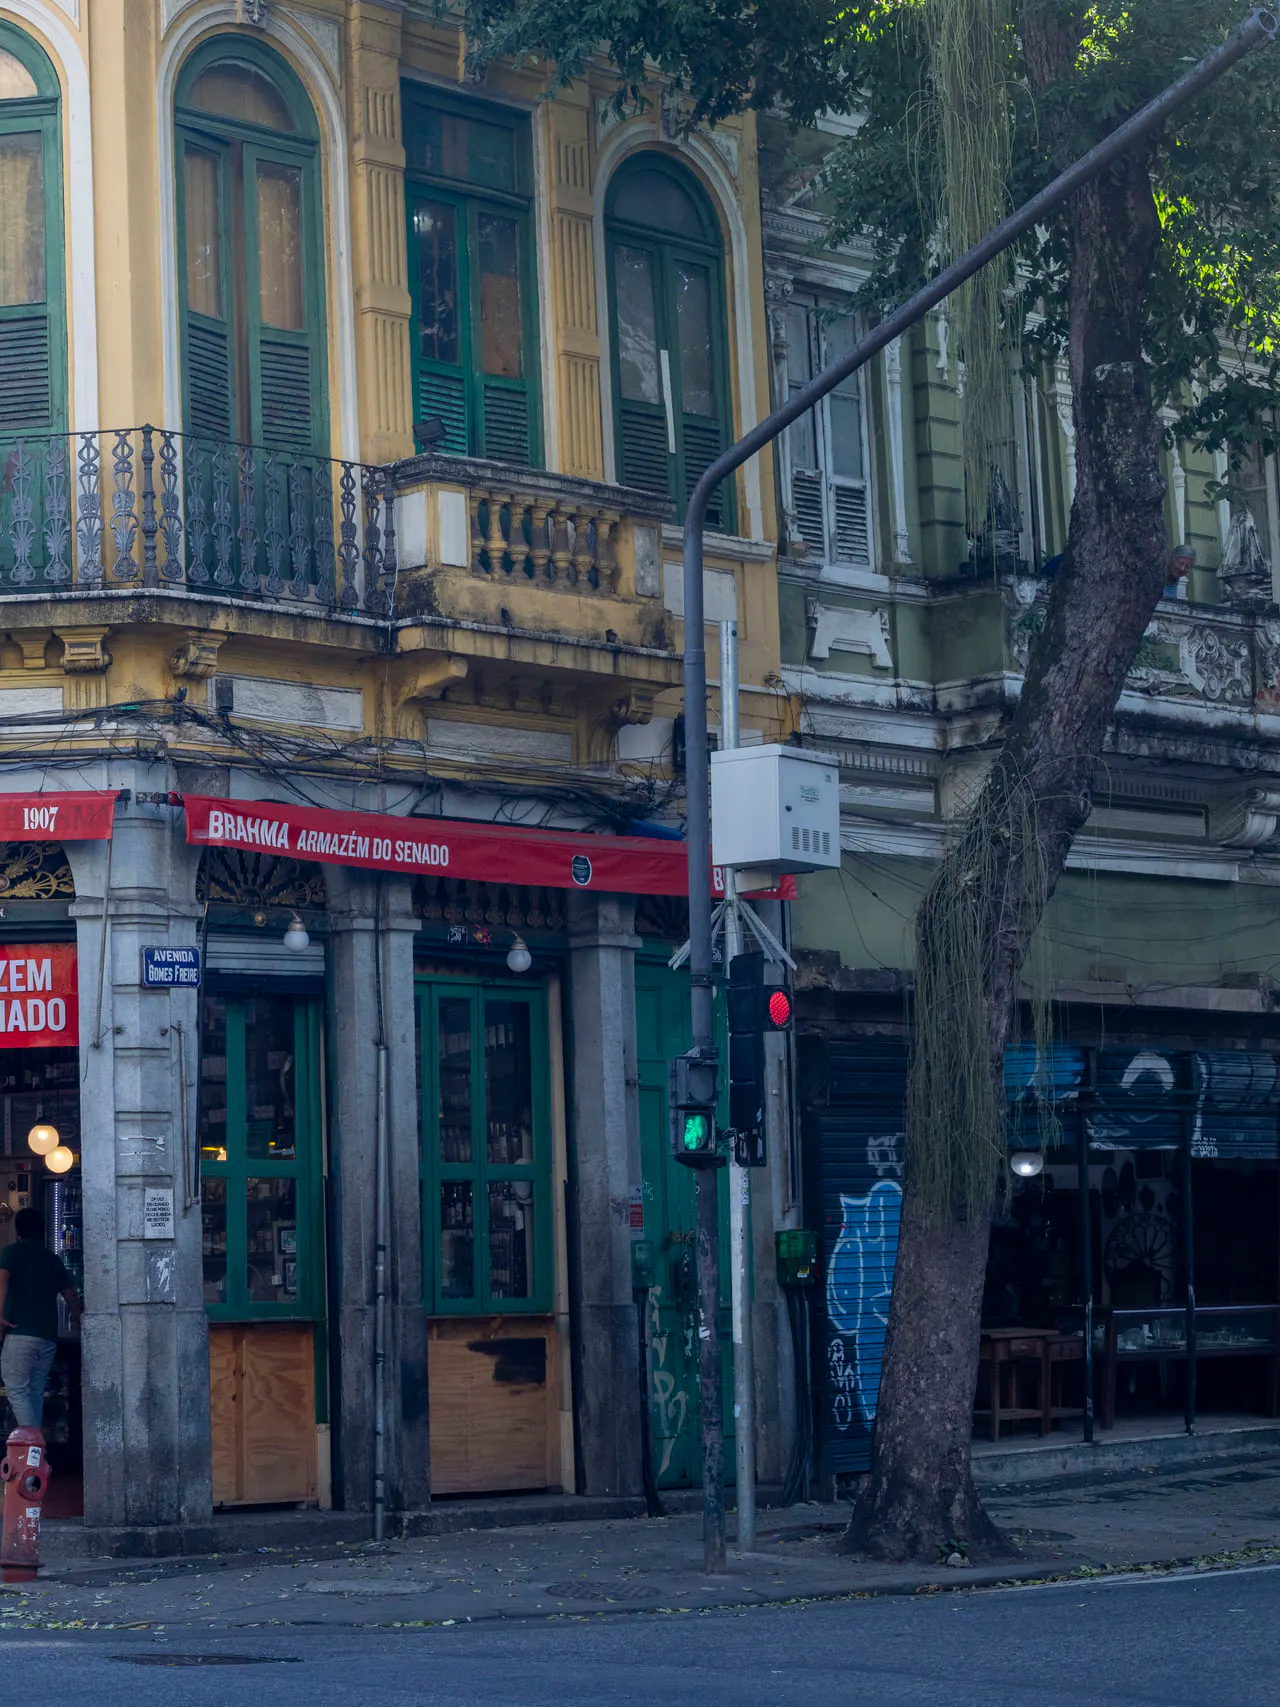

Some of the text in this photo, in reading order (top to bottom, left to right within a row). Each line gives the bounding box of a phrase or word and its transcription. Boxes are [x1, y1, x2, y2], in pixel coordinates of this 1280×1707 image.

[23, 806, 59, 833] 1907
[208, 810, 449, 867] BRAHMA ARMAZÉM DO SENADO
[153, 950, 195, 963] AVENIDA
[148, 964, 198, 983] GOMES FREIRE
